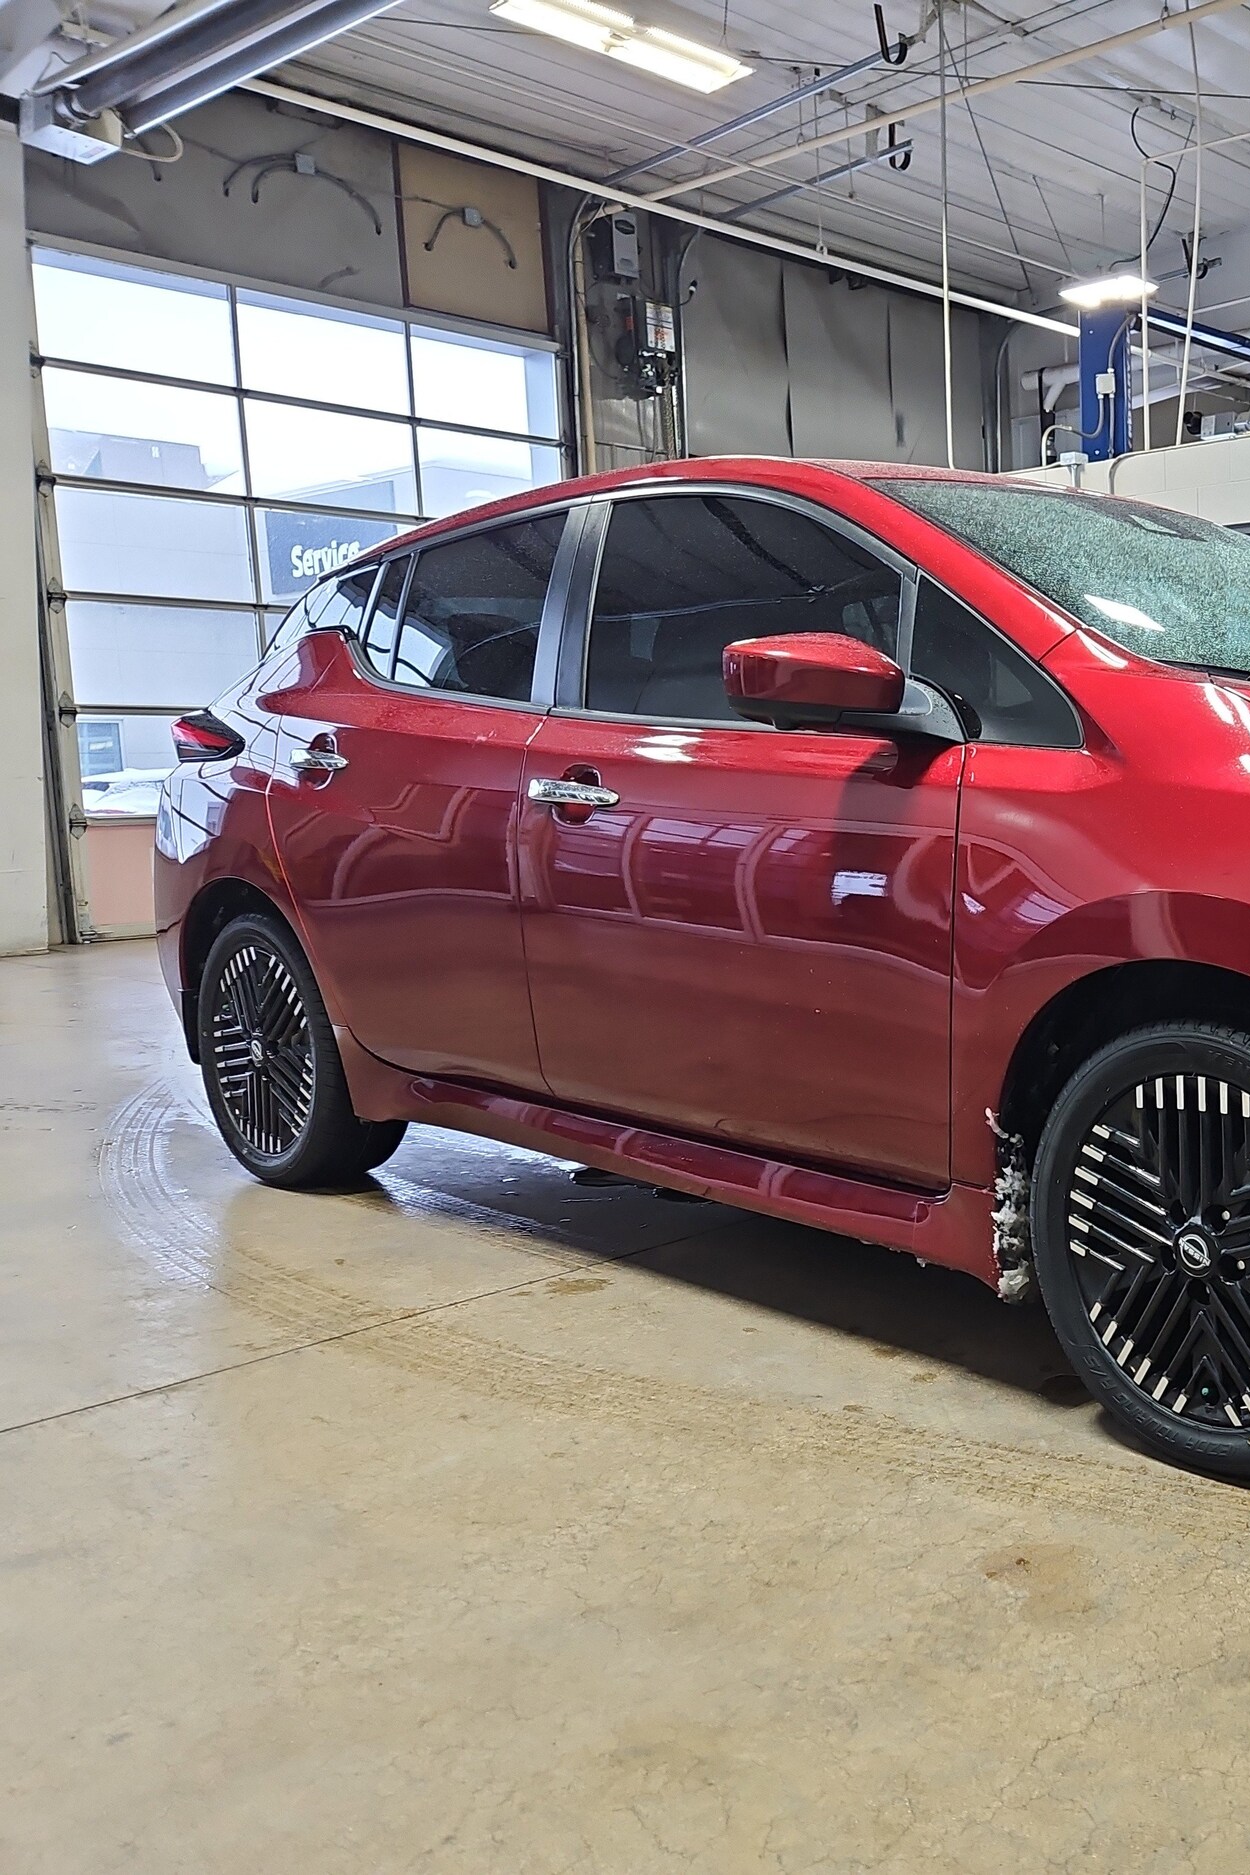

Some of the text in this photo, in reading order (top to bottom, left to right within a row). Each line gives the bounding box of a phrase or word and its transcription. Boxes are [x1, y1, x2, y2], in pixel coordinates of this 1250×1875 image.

[1178, 1236, 1211, 1267] NISSAN
[1081, 1355, 1118, 1391] A/S
[1112, 1392, 1180, 1444] TOURING
